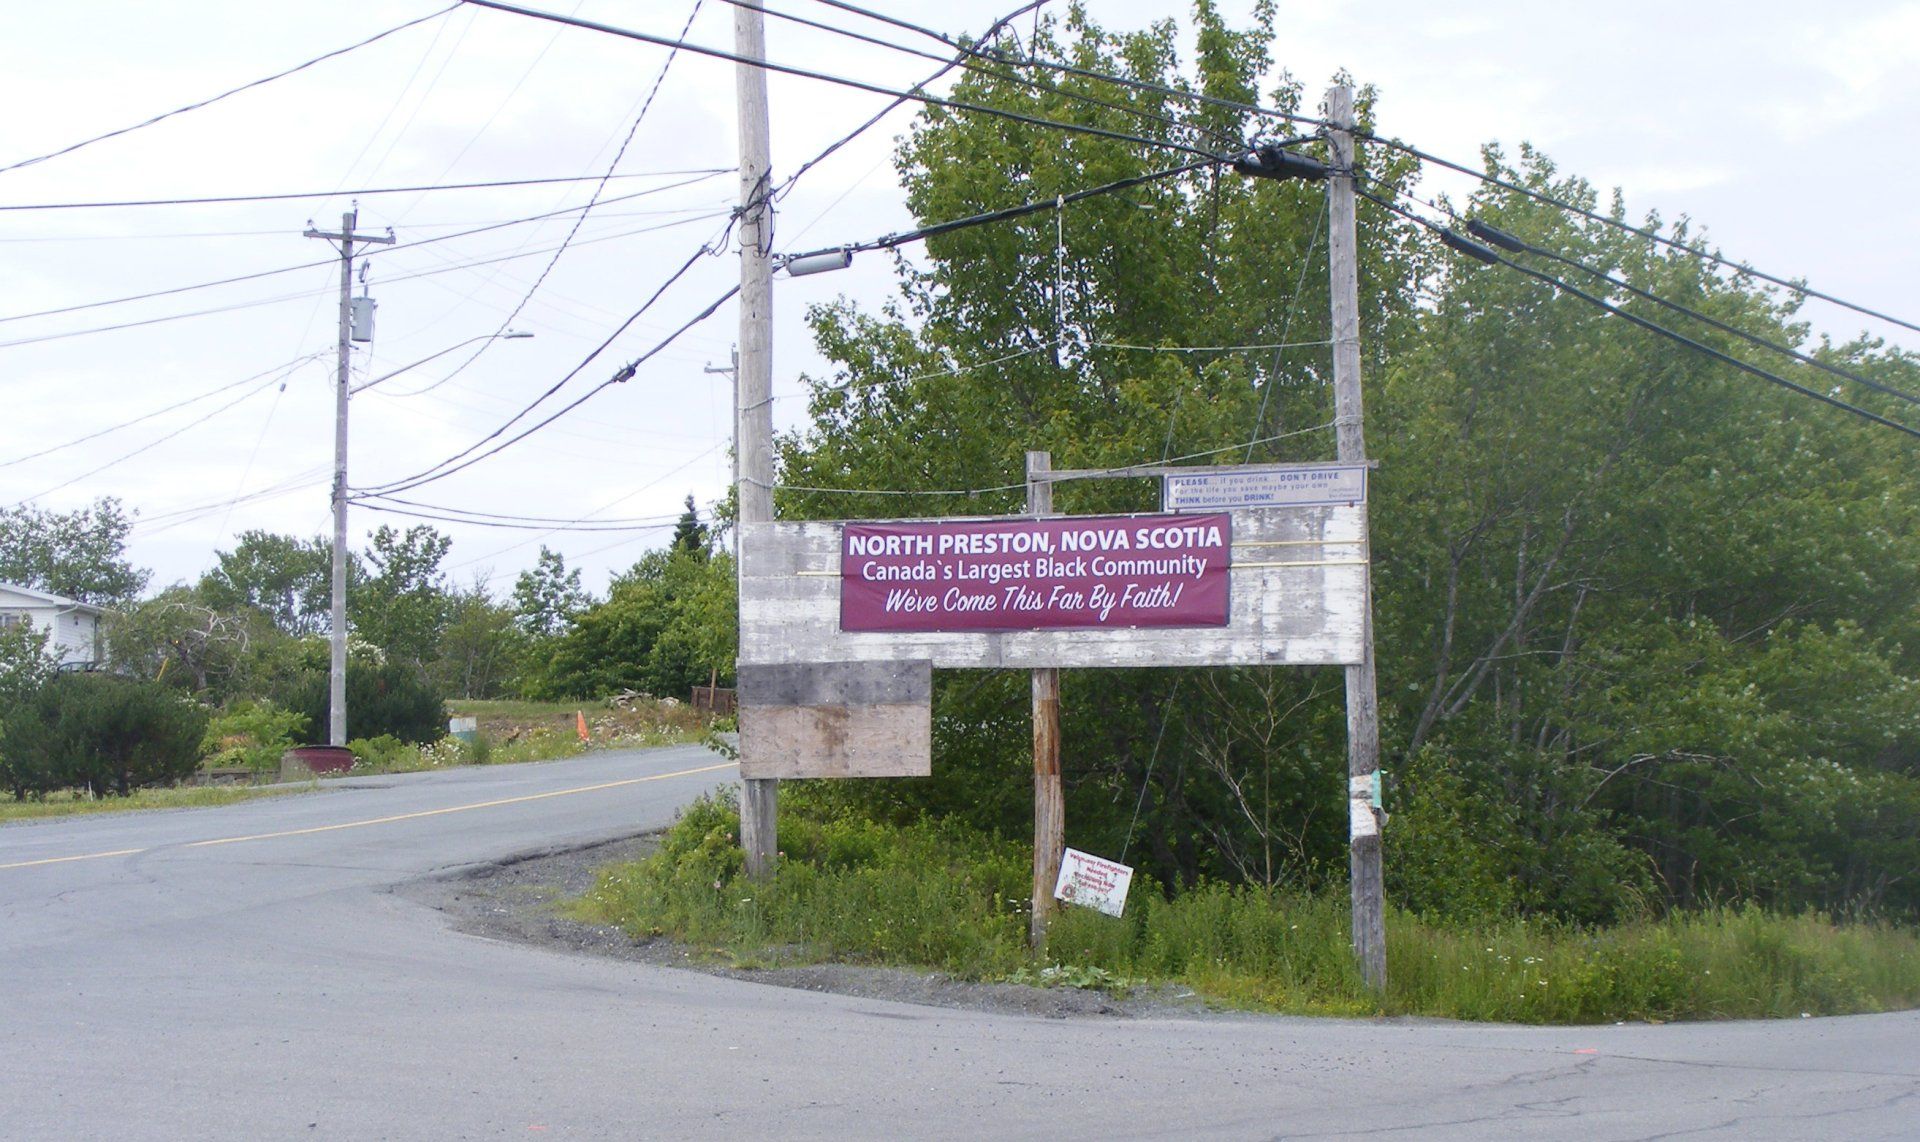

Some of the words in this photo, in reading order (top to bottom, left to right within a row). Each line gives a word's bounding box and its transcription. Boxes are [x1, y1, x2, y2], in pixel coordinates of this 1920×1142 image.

[1229, 477, 1243, 485] you
[1281, 473, 1307, 481] DONT
[1311, 472, 1339, 480] DRIVE
[1202, 496, 1226, 504] before
[1244, 493, 1274, 501] DRINK!
[850, 534, 933, 556] NORTH
[939, 531, 1056, 555] PRESTON,
[1061, 529, 1130, 552] NOVA
[1136, 526, 1223, 550] SCOTIA
[958, 559, 1031, 584] Largest
[1036, 556, 1087, 578] Black
[1091, 554, 1208, 579] Community
[943, 587, 998, 612] Come
[1002, 584, 1045, 611] This
[1047, 585, 1084, 610] Far
[1088, 583, 1117, 622] By
[1120, 581, 1184, 608] Faith!
